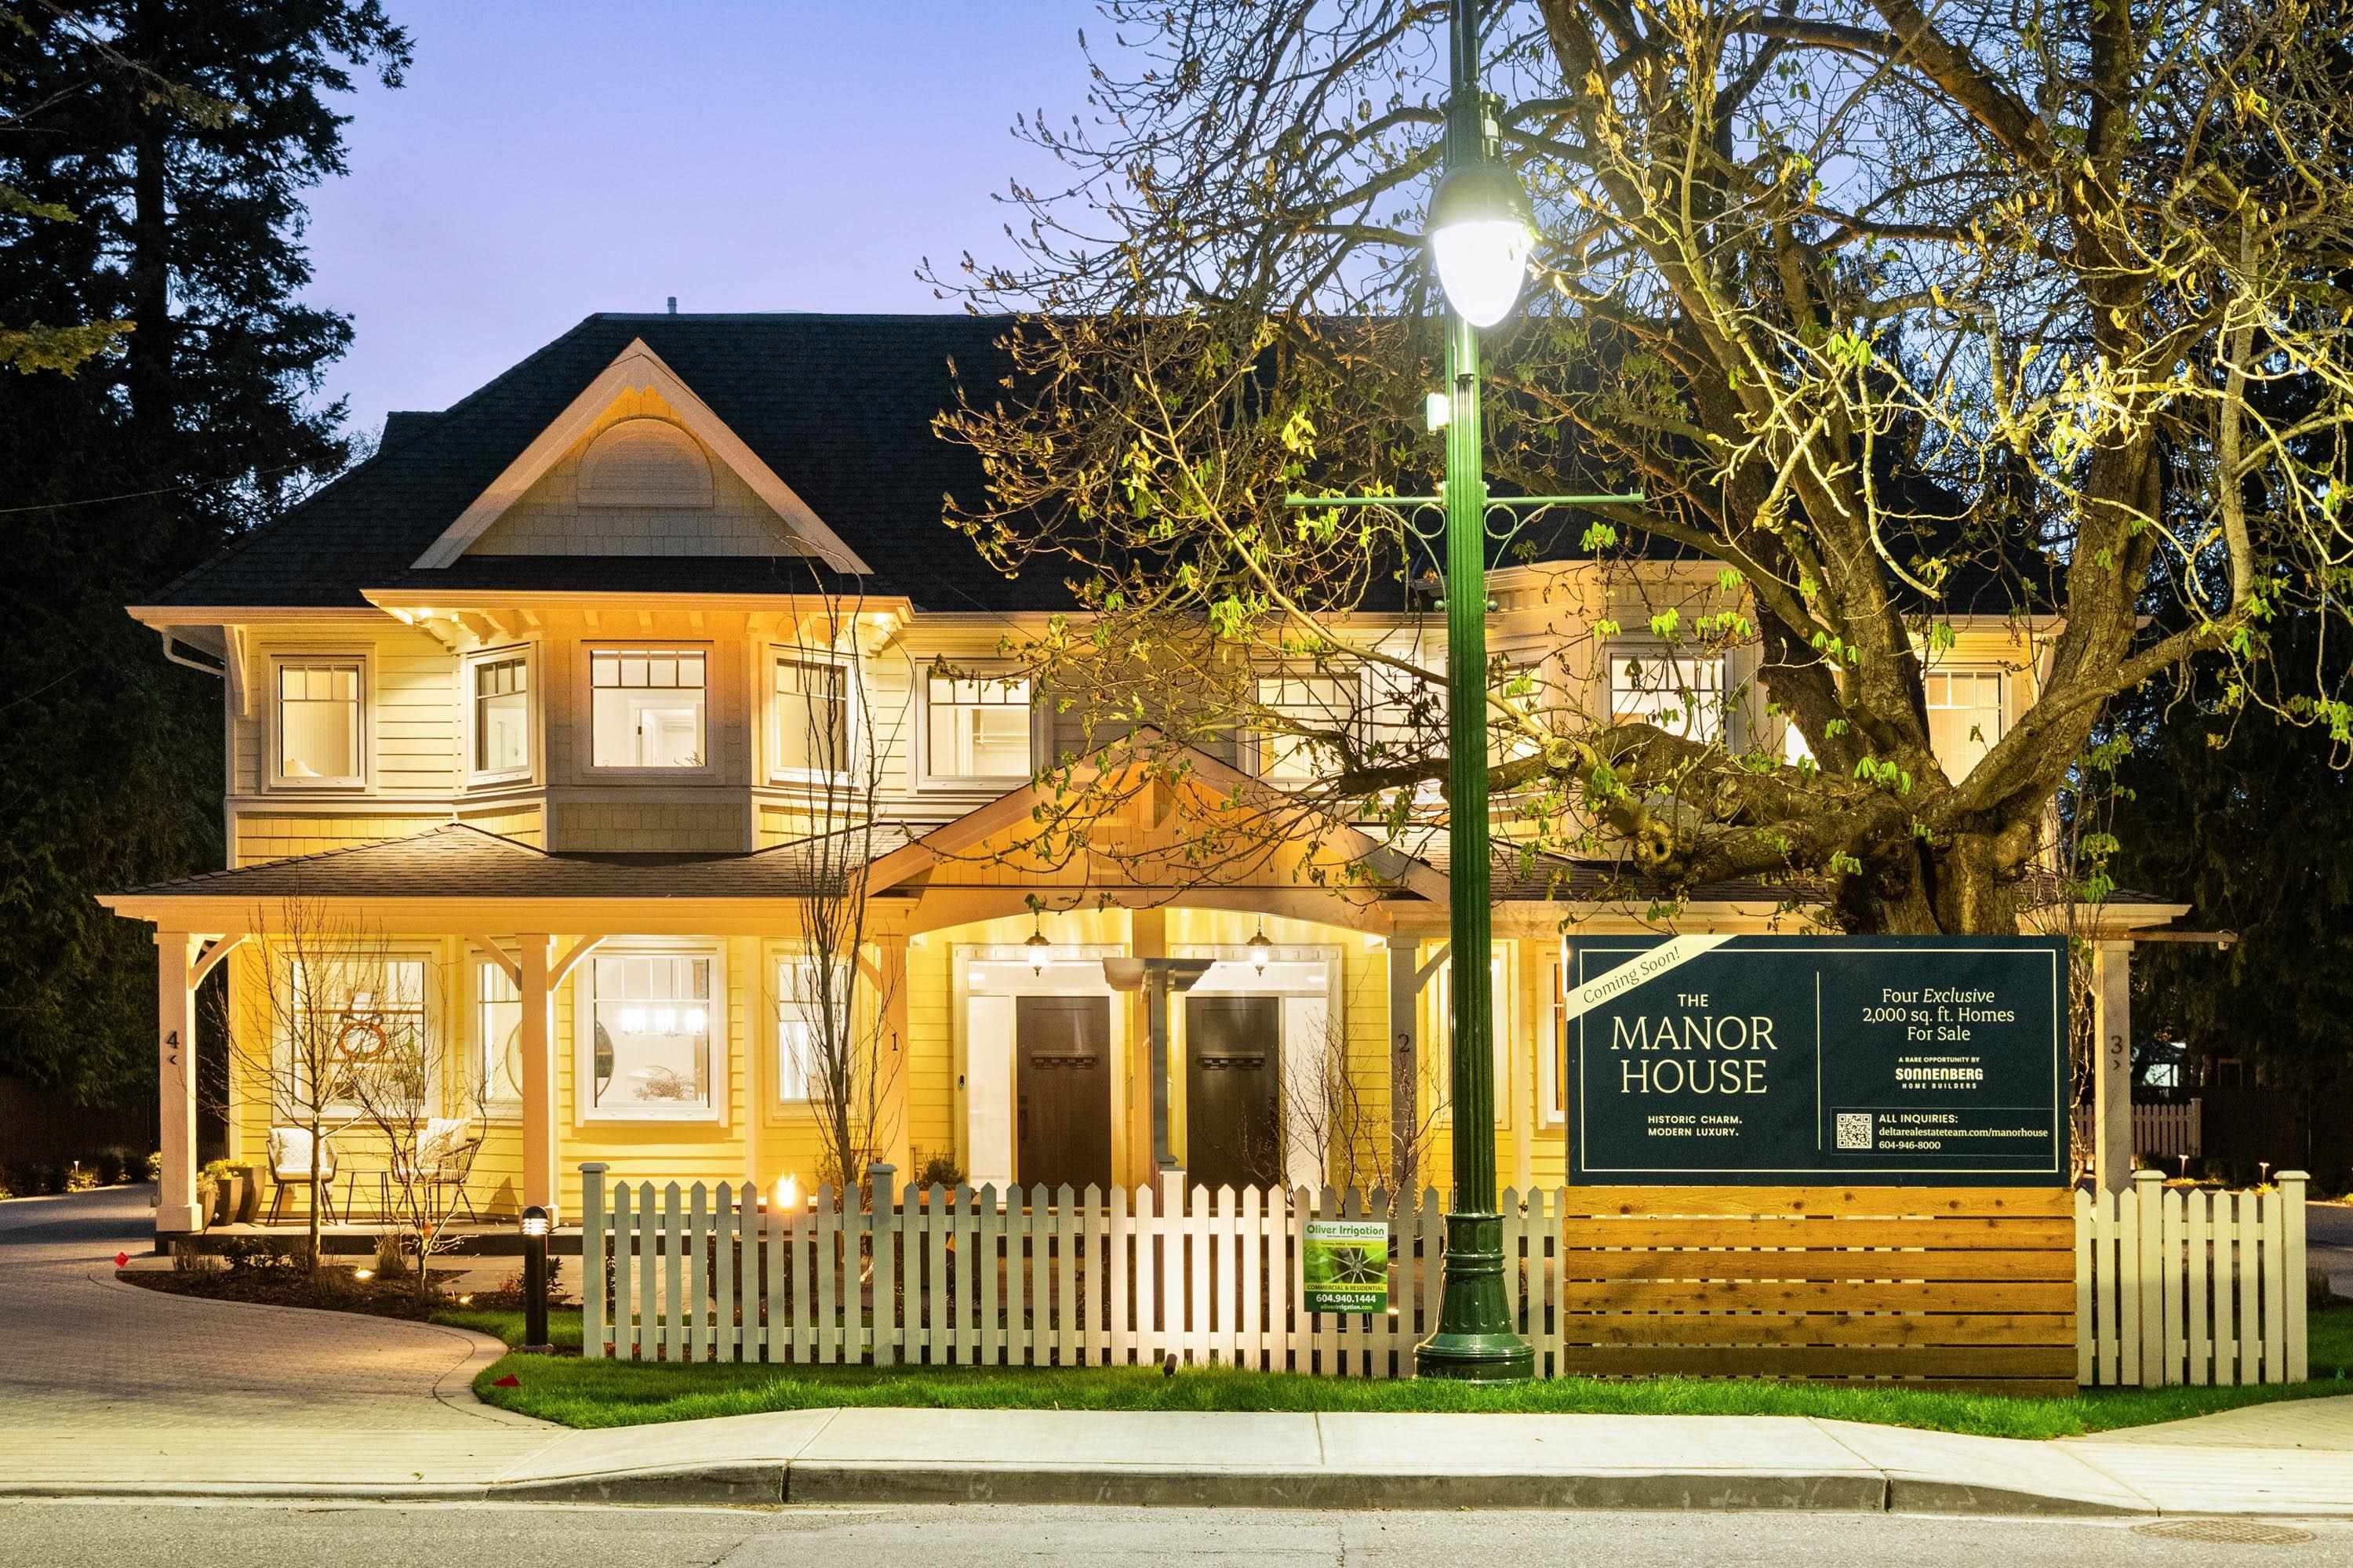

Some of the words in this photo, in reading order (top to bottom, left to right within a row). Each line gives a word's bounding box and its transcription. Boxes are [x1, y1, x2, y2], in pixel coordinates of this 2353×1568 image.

[1583, 968, 1639, 1004] Coming
[1640, 945, 1681, 976] Soon!
[1677, 994, 1709, 1007] THE
[1882, 988, 1918, 1003] Four
[1923, 987, 1995, 1003] Exclusive
[1863, 1007, 1907, 1024] 2,000
[1911, 1010, 1933, 1025] sq.
[1937, 1006, 1953, 1022] ft.
[1958, 1007, 2015, 1022] Homes
[166, 1031, 180, 1050] 4
[1610, 1016, 1778, 1050] MANOR
[1907, 1026, 1933, 1041] For
[1937, 1025, 1971, 1041] Sale
[891, 1032, 898, 1051] 1
[1398, 1034, 1410, 1053] 2
[2111, 1035, 2122, 1053] 3
[1620, 1059, 1767, 1093] HOUSE
[1895, 1068, 1984, 1080] SONNENBERG
[1878, 1114, 1897, 1123] ALL
[1900, 1114, 1958, 1124] INQUIRIES:
[1878, 1126, 2048, 1137] deltarealestateteam.com/manorhouse
[1878, 1141, 1941, 1150] 604-946-8000
[1307, 1224, 1337, 1234] Oliver
[1340, 1225, 1385, 1237] Irrigation
[1316, 1293, 1377, 1303] 604.940.1444
